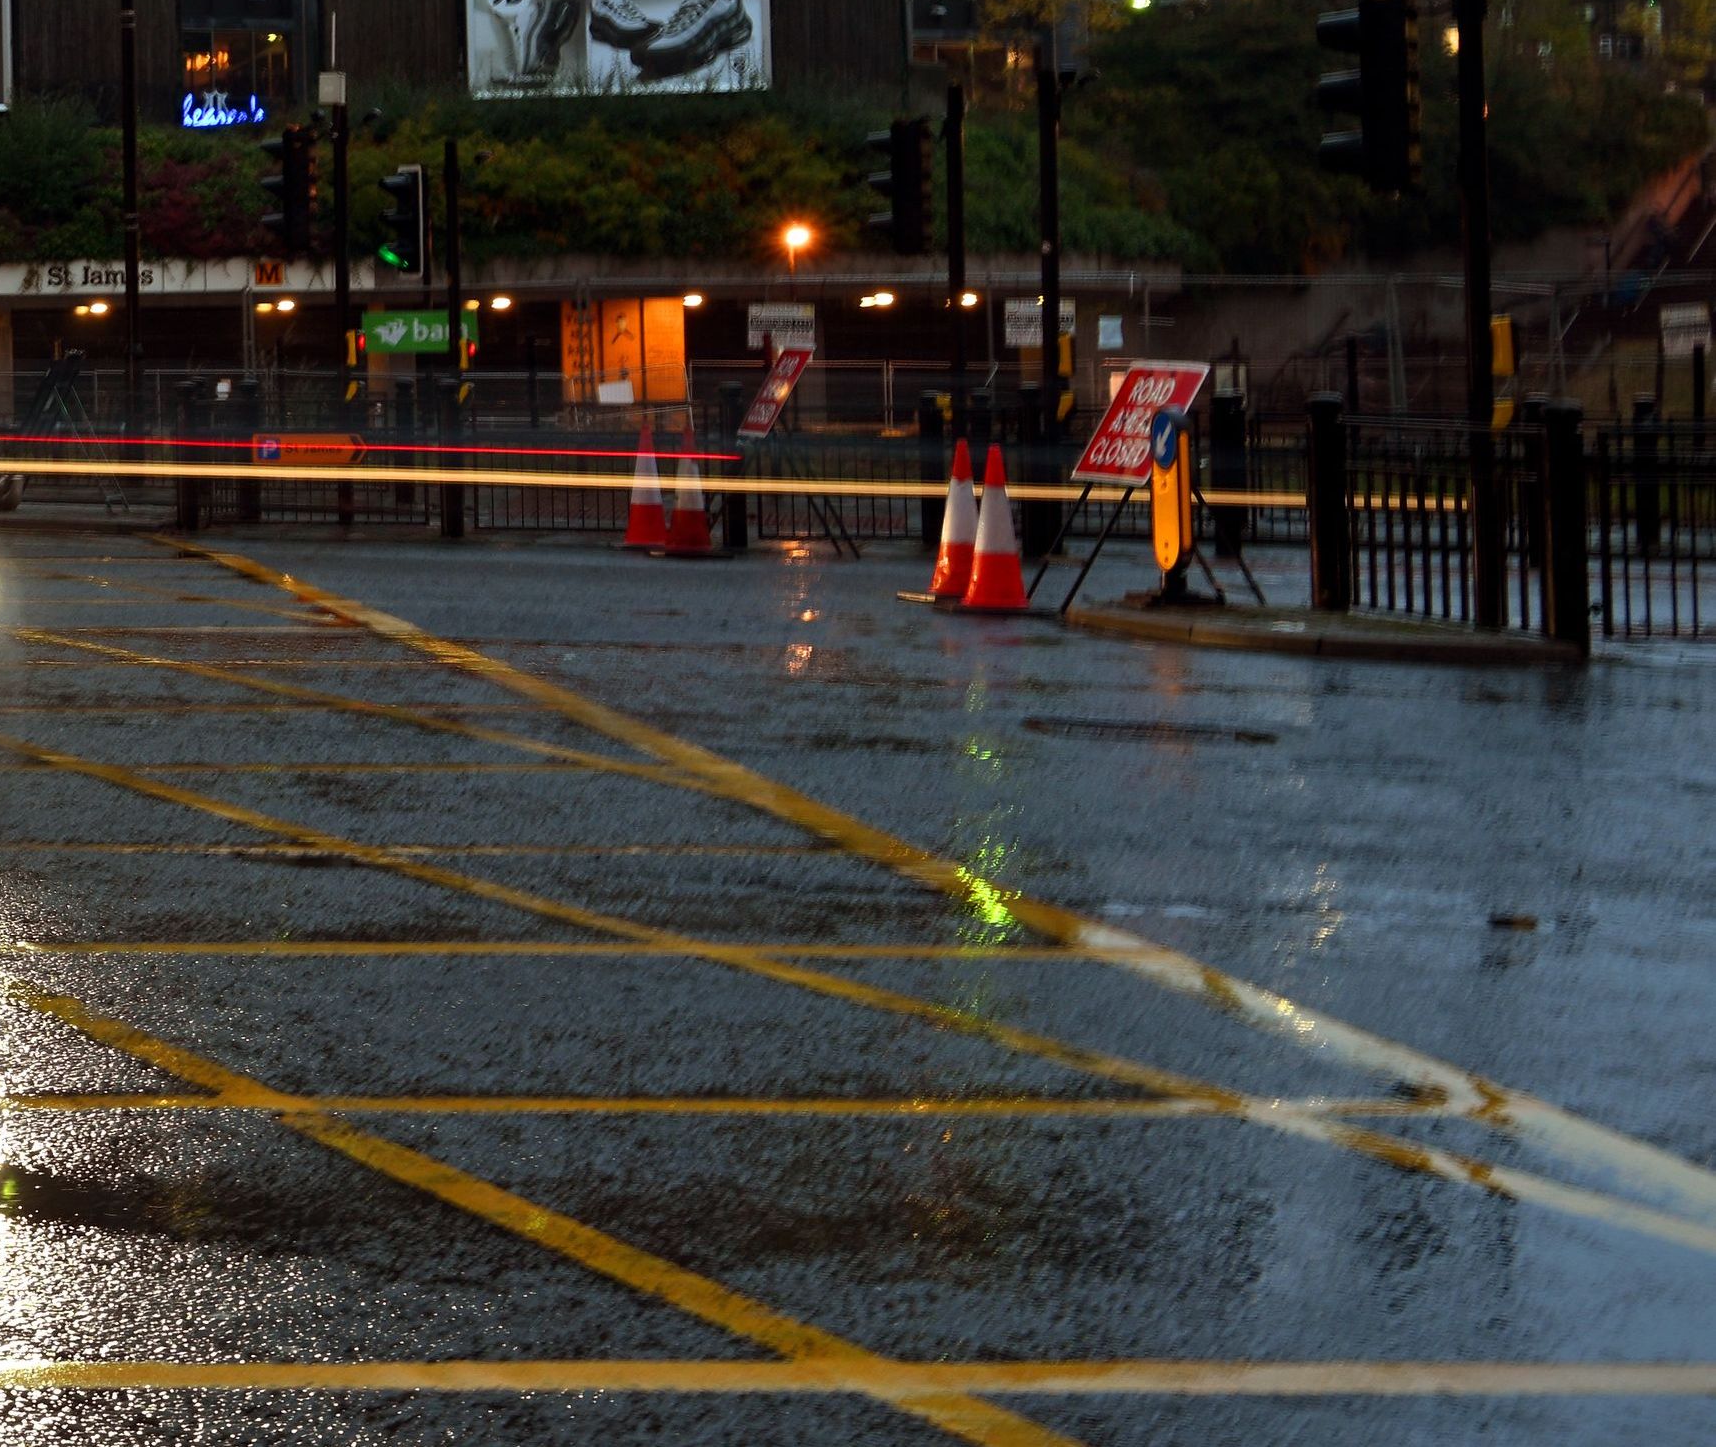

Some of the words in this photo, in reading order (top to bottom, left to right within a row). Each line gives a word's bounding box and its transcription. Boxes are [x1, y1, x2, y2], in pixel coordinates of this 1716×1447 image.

[47, 266, 71, 286] St
[81, 266, 154, 285] Jams
[259, 264, 280, 283] M
[1127, 377, 1176, 406] ROAD
[1108, 407, 1152, 436] AHEA
[1089, 437, 1151, 468] CLOSED
